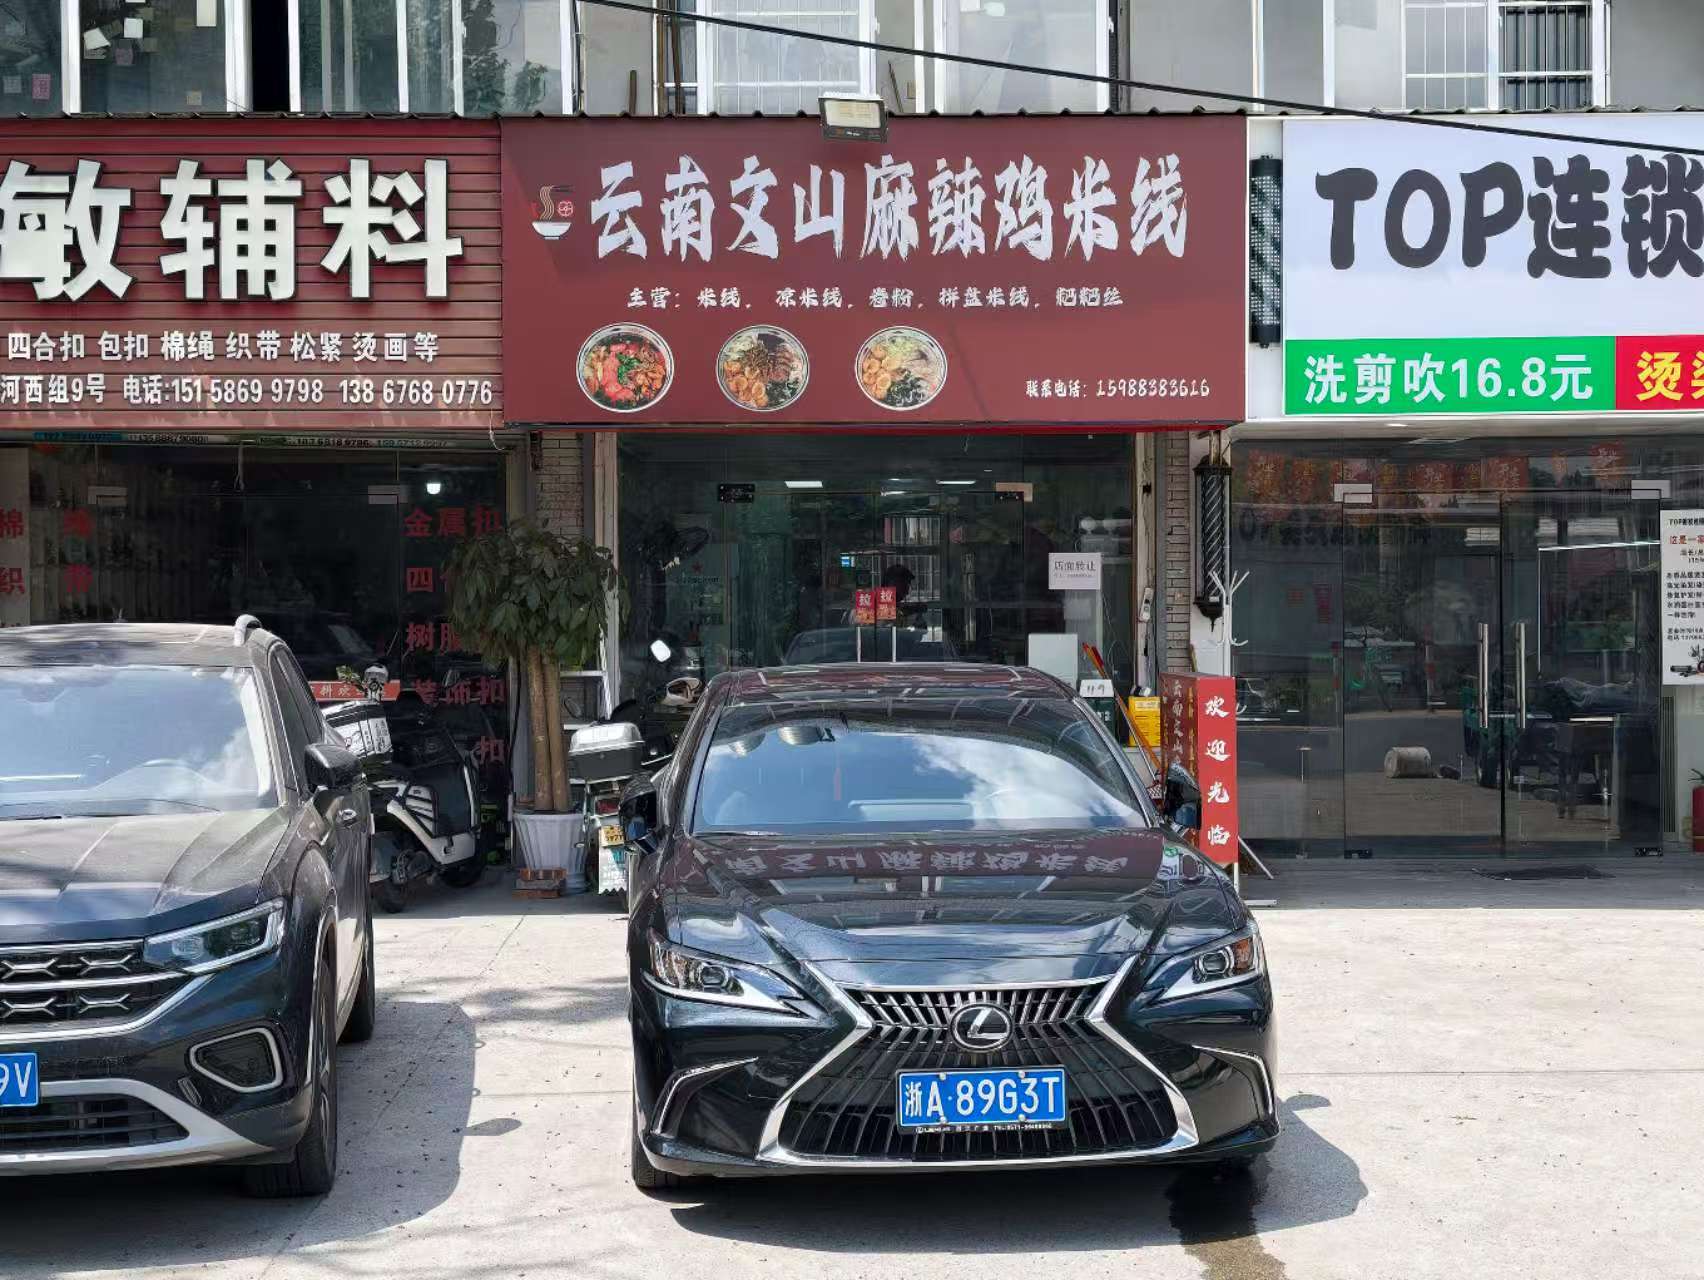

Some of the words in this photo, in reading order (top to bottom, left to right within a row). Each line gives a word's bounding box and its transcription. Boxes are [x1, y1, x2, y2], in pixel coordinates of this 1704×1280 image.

[160, 158, 464, 300] 辅料
[591, 153, 1188, 262] 云南文山麻辣鸡米线
[8, 331, 85, 361] 四合扣
[97, 330, 149, 360] 包扣
[161, 331, 215, 362] 棉绳
[290, 332, 343, 362] 松紧
[352, 331, 440, 362] 烫画等
[0, 373, 106, 405] 河西组9号
[210, 379, 263, 403] 5869
[271, 379, 324, 403] 9798
[339, 380, 374, 403] 138
[382, 380, 434, 404] 6768
[442, 381, 492, 404] 0776
[1096, 378, 1210, 398] 15988383616
[1303, 353, 1593, 404] 洗剪吹16.8元
[1204, 695, 1231, 846] 欢迎光临
